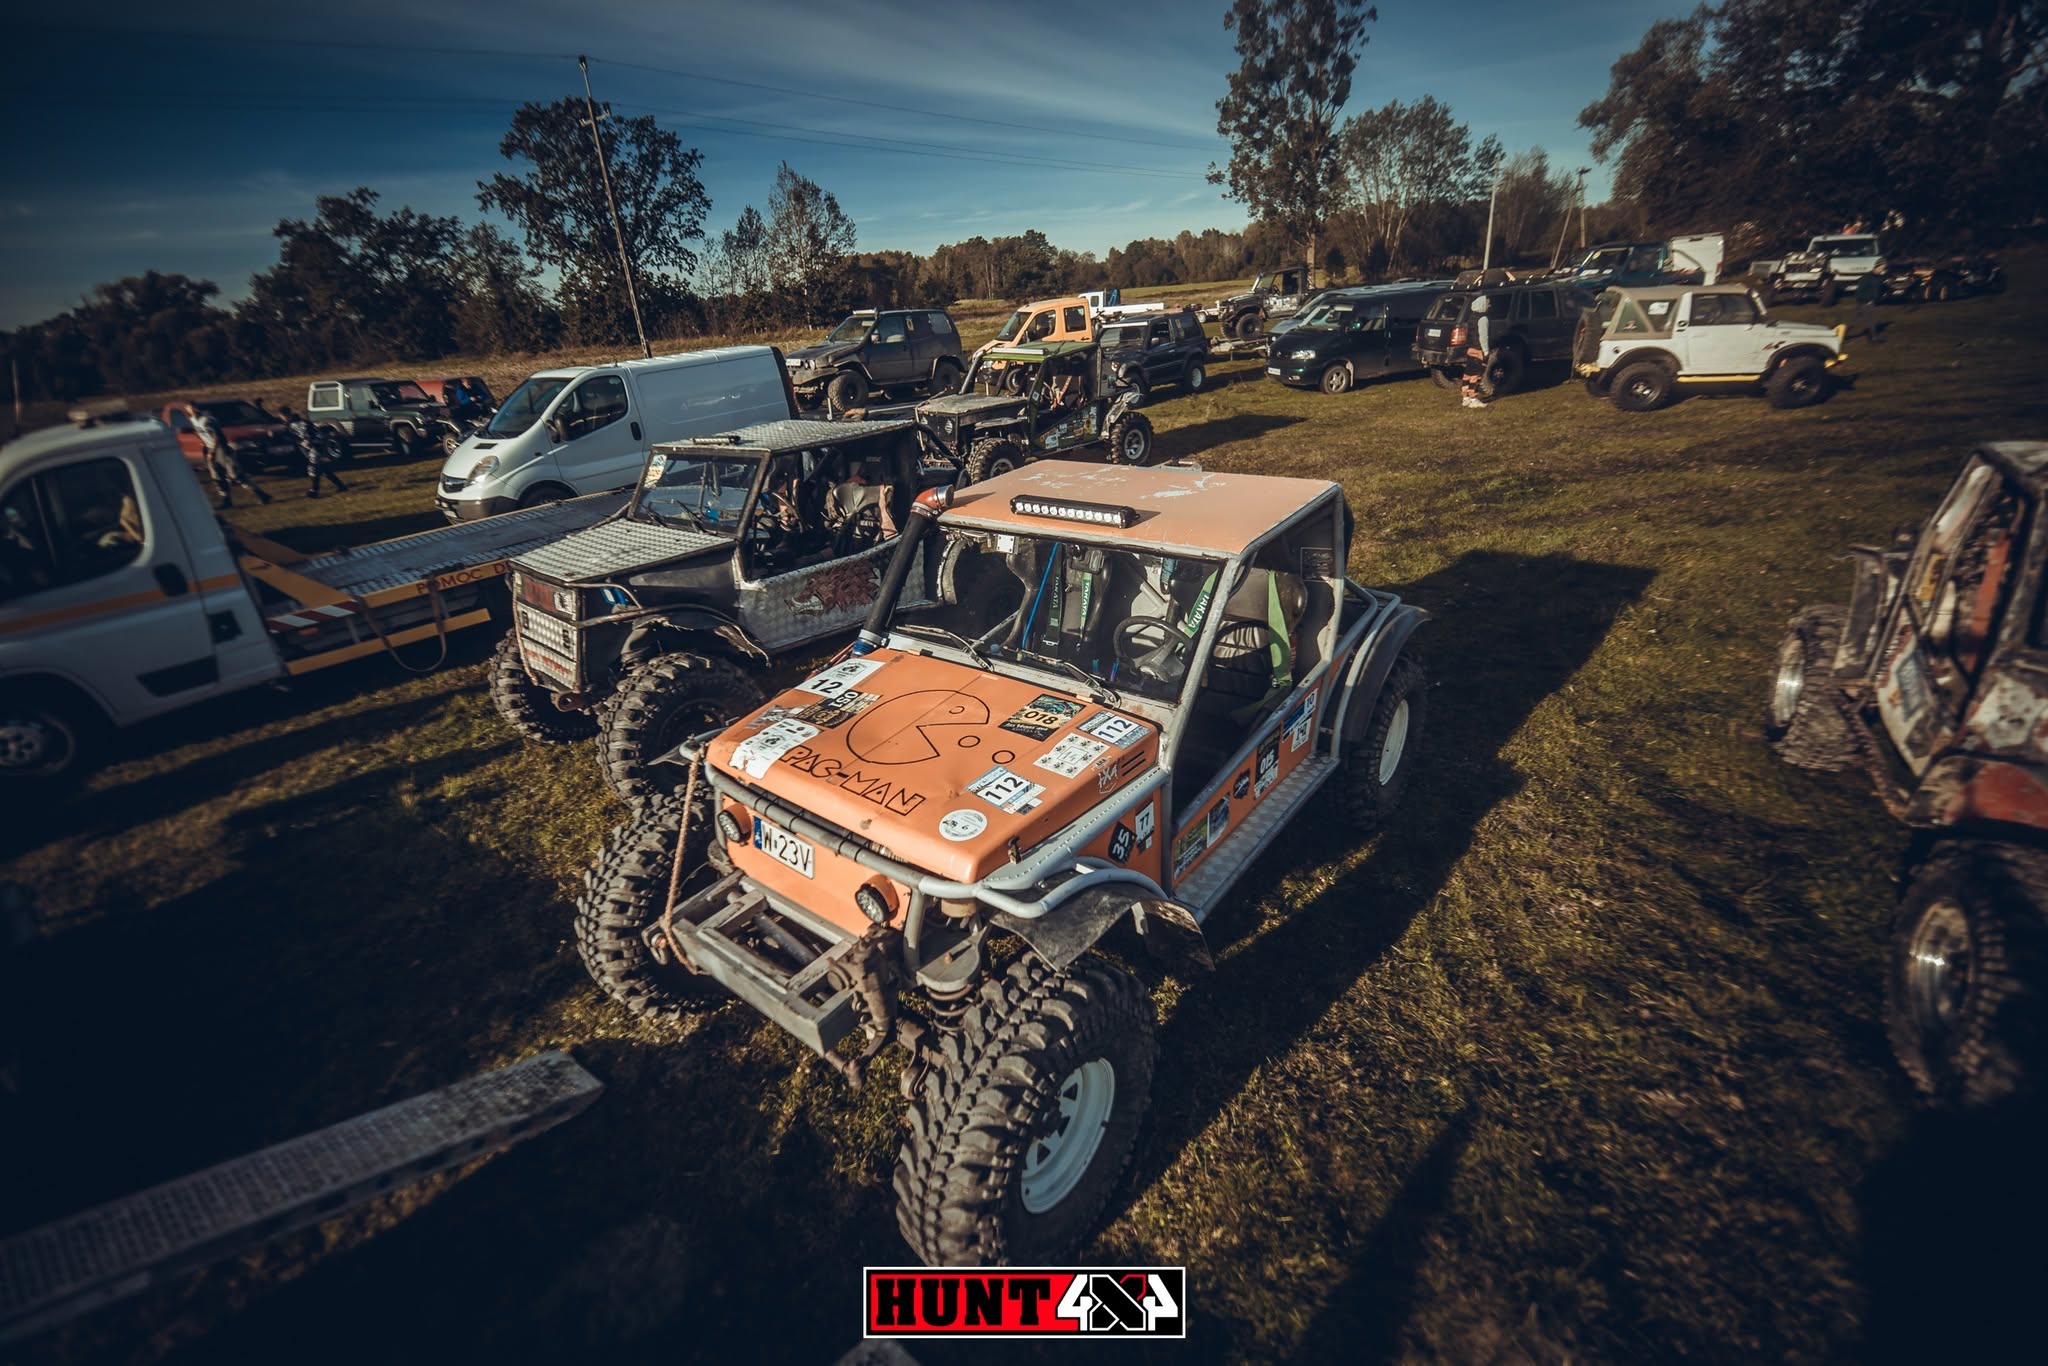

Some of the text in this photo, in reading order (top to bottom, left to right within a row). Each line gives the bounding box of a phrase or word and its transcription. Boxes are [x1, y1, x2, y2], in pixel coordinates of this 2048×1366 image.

[1188, 594, 1211, 629] TAKATA
[810, 678, 843, 694] 12
[1024, 711, 1058, 725] 018
[1098, 719, 1132, 738] 112
[779, 744, 926, 817] PAC-MAN
[985, 776, 1023, 800] 112
[1112, 828, 1129, 859] 35
